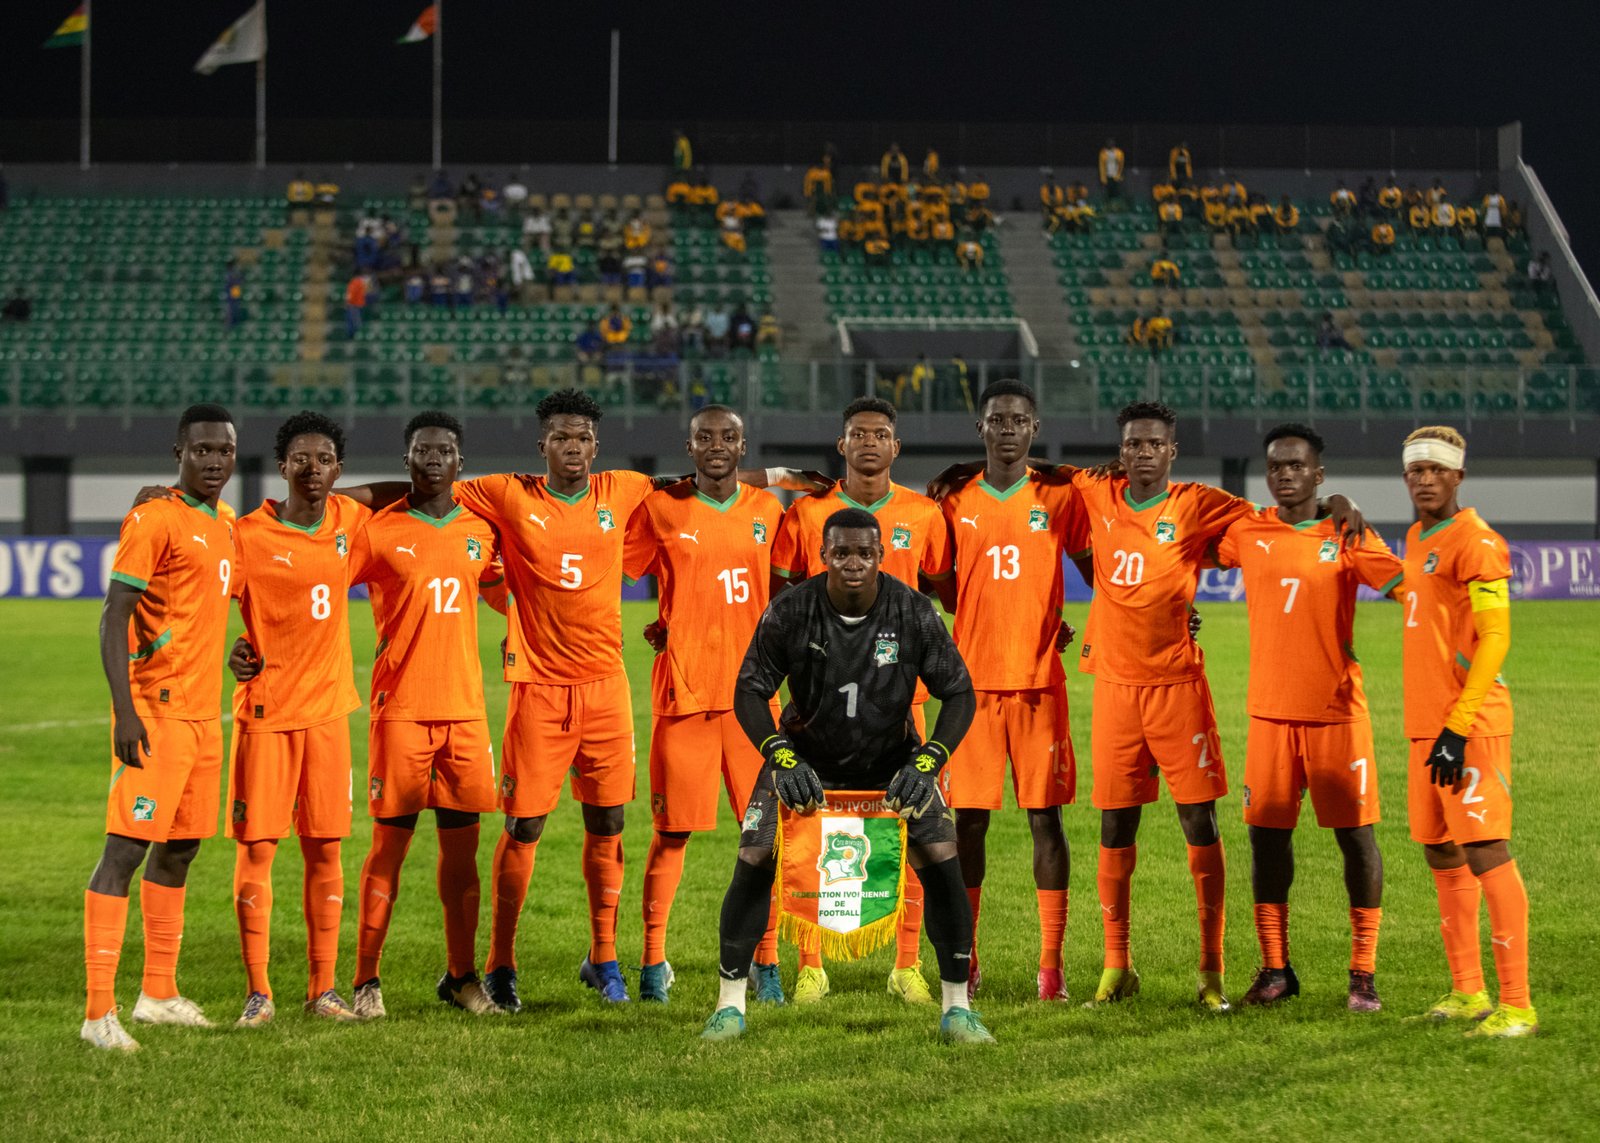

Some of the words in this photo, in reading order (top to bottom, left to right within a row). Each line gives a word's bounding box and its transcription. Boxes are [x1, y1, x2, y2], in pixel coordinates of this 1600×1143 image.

[219, 558, 231, 596] 9
[559, 553, 583, 589] 5
[986, 544, 1021, 580] 13
[1110, 549, 1145, 586] 20
[1538, 546, 1600, 587] PE
[310, 583, 331, 620] 8
[427, 577, 461, 614] 12
[716, 567, 750, 605] 15
[1280, 577, 1301, 614] 7
[1406, 591, 1419, 628] 2
[838, 682, 859, 718] 1
[1350, 757, 1368, 796] 7
[1461, 766, 1485, 805] 2
[843, 890, 890, 898] IVOIRIENNE
[818, 909, 860, 917] FOOTBALL
